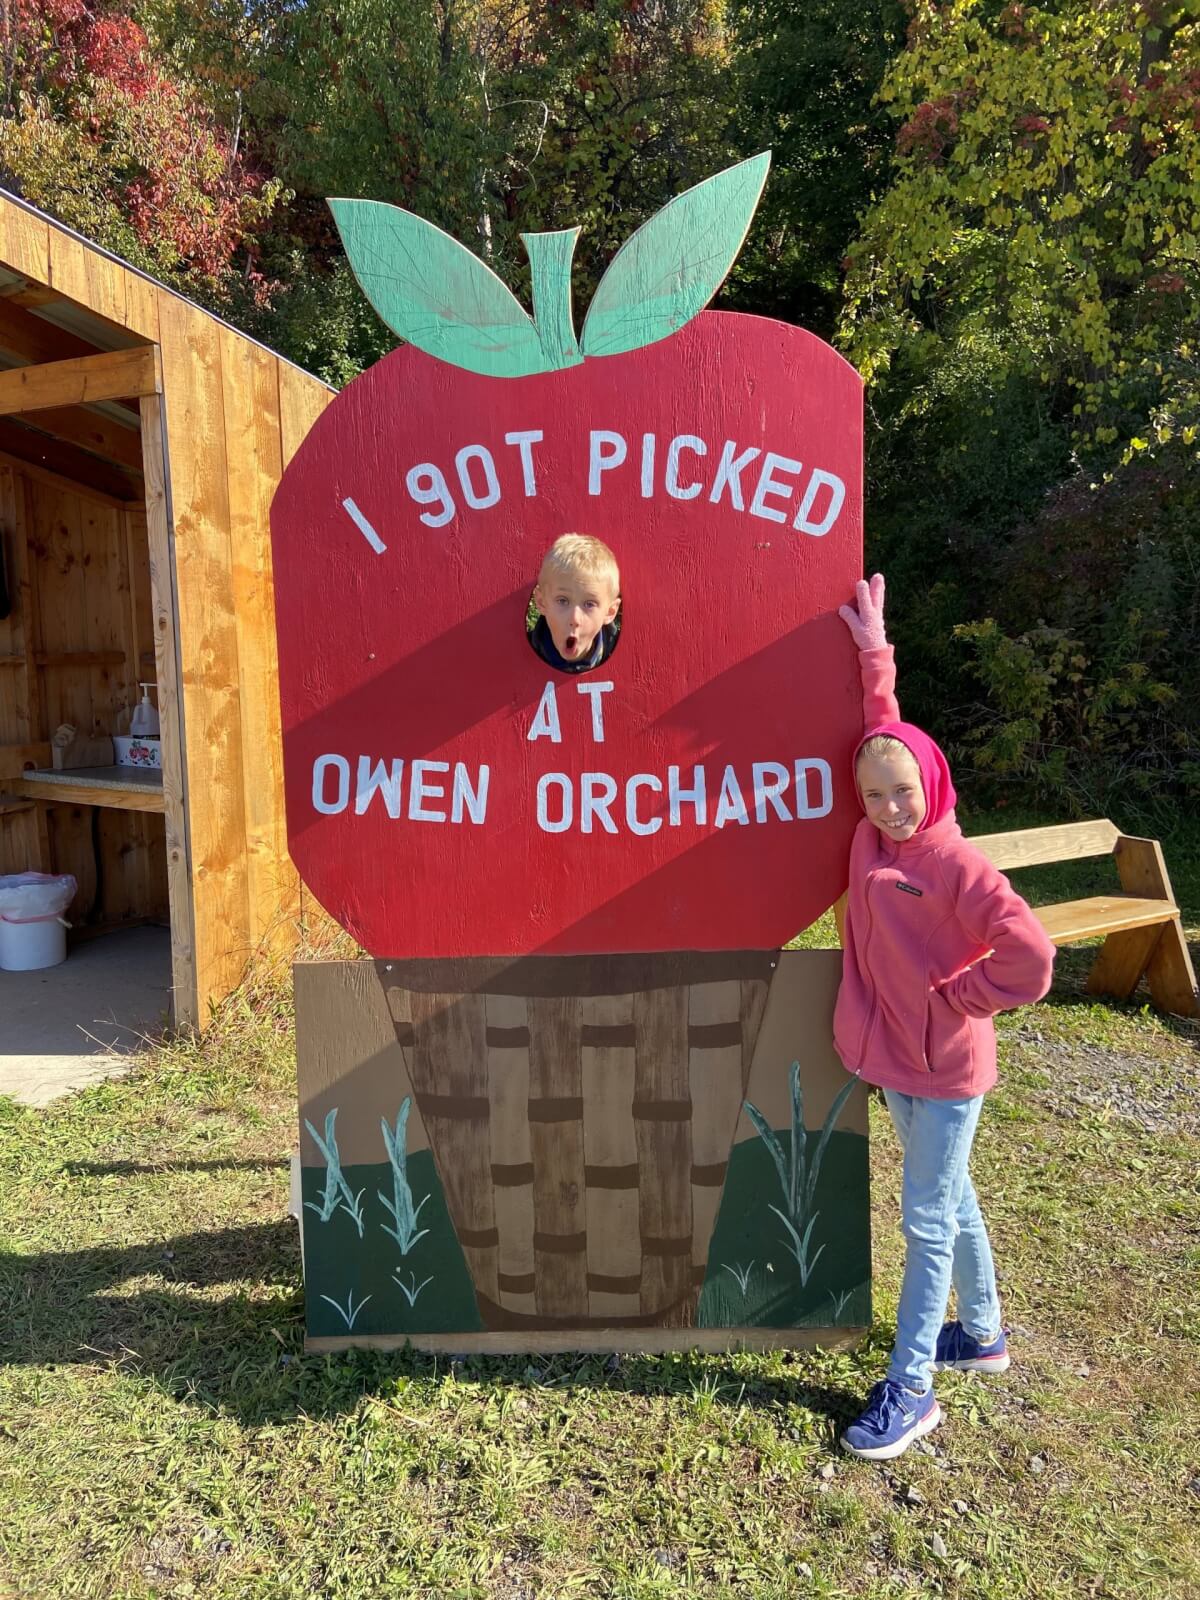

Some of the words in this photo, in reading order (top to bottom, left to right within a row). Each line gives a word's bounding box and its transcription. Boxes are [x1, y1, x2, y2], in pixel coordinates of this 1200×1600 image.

[342, 496, 388, 555] I
[588, 429, 846, 537] PICKED
[526, 680, 615, 743] AT
[312, 753, 490, 825] OWEN
[536, 757, 834, 836] ORCHARD
